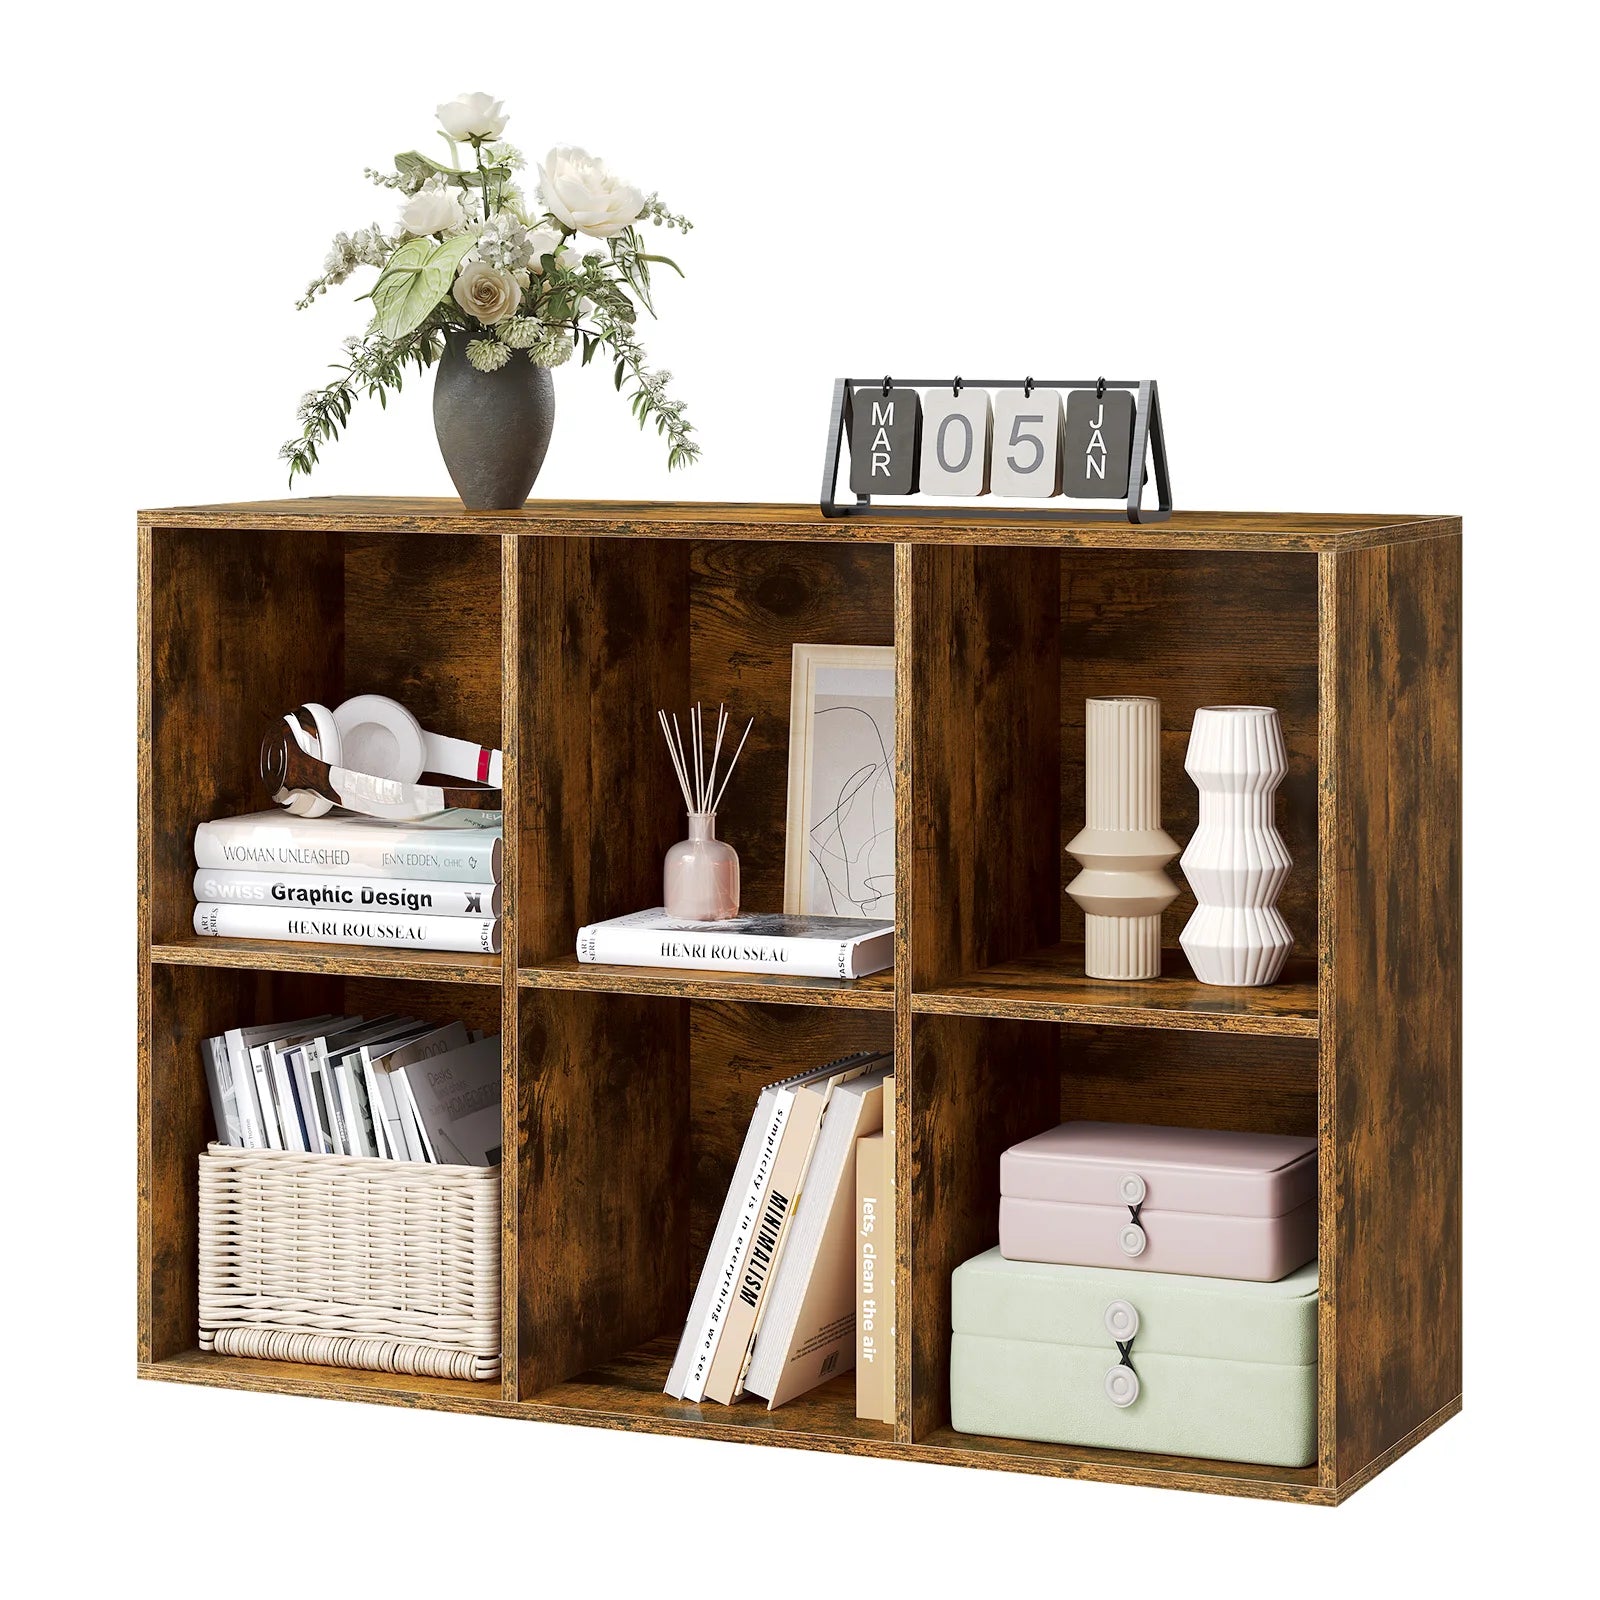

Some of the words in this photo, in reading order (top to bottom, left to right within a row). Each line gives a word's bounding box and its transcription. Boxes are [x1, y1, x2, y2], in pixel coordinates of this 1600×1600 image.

[871, 401, 895, 477] MAR
[1086, 404, 1108, 480] JAN
[223, 846, 275, 862] WOMAN
[279, 847, 350, 866] UNLEASHED
[382, 852, 404, 866] JENN
[406, 853, 441, 868] EDDEN,
[204, 880, 265, 899] Swiss
[271, 882, 354, 906] Graphic
[361, 886, 433, 911] Design
[201, 914, 209, 932] ART
[288, 920, 338, 936] HENRI
[343, 922, 428, 941] ROUSSEAU
[661, 942, 706, 958] HENRI
[711, 944, 789, 963] ROUSSEAU
[753, 1109, 783, 1190] simplicity
[748, 1195, 758, 1209] is
[741, 1215, 752, 1230] in
[859, 1197, 877, 1237] lets,
[740, 1189, 789, 1308] MINIMALISM
[711, 1236, 743, 1322] everything
[862, 1242, 877, 1293] clean
[862, 1299, 877, 1331] the
[704, 1328, 715, 1349] we
[862, 1335, 877, 1363] air
[694, 1355, 706, 1381] see
